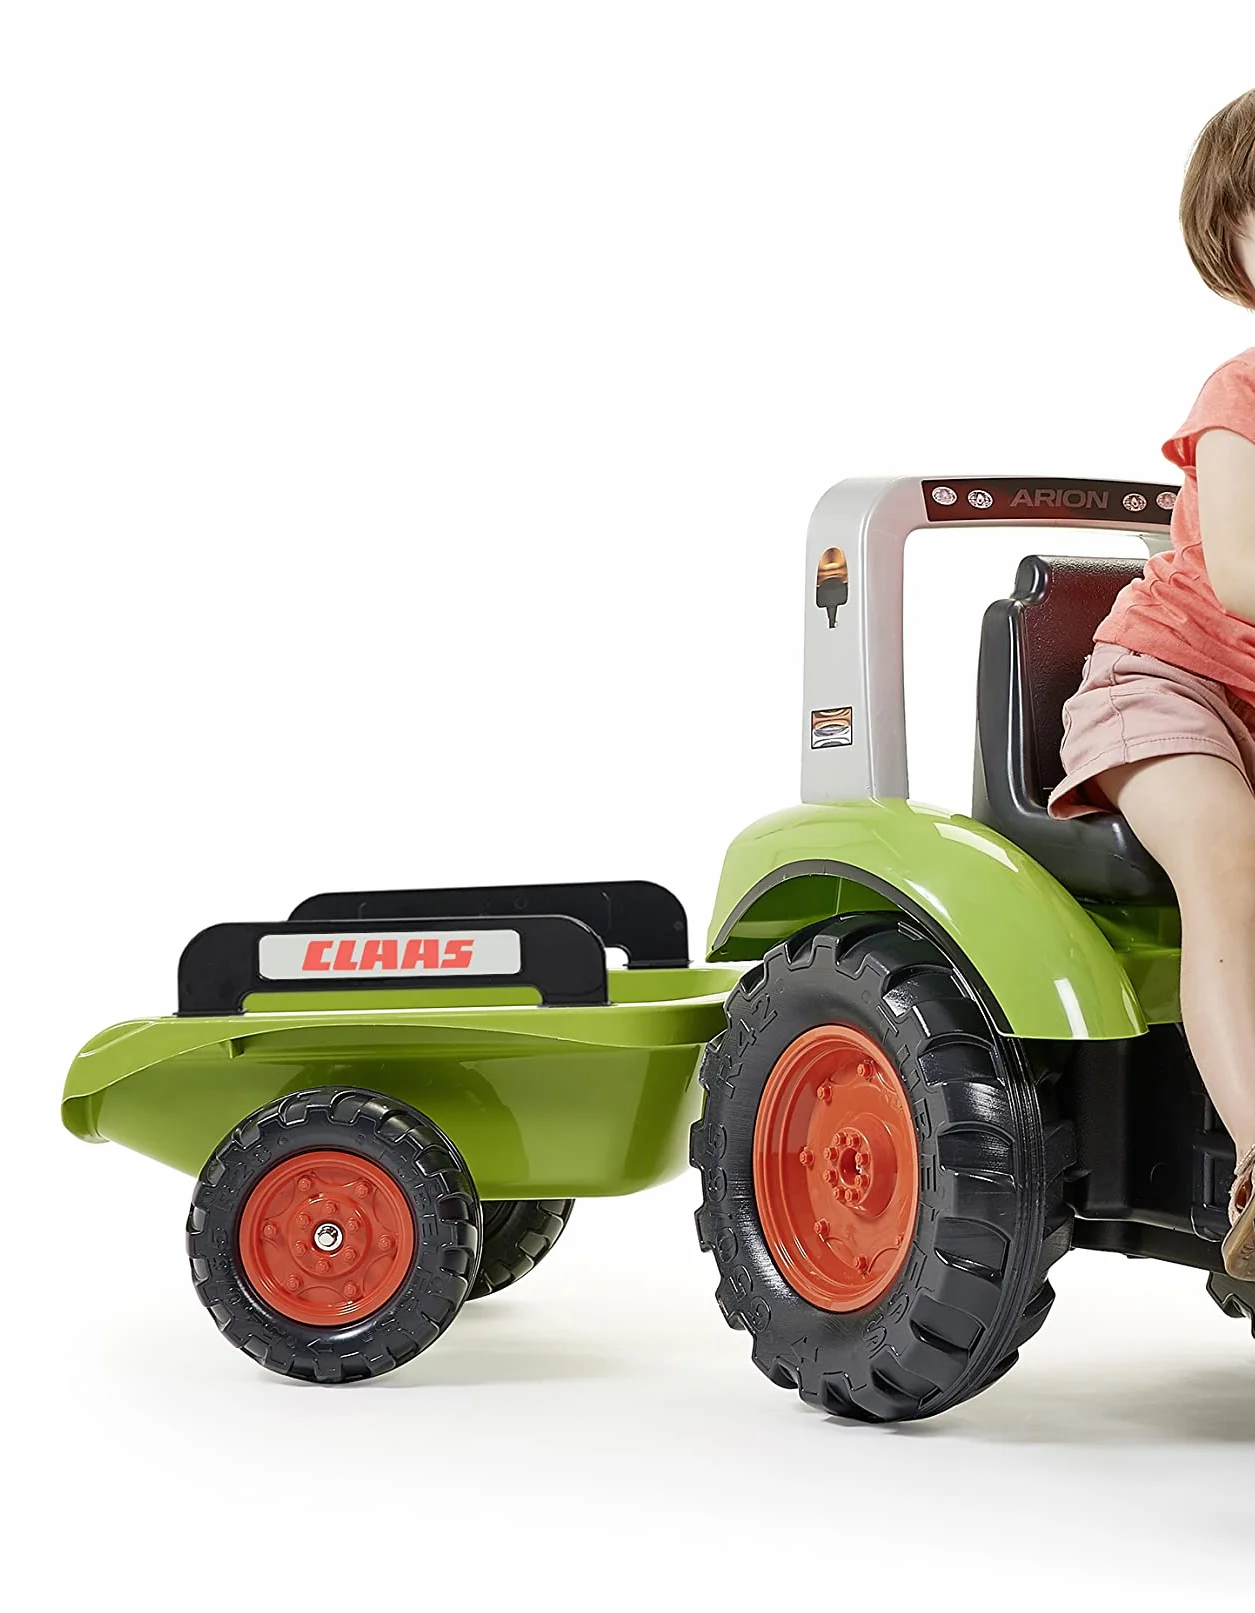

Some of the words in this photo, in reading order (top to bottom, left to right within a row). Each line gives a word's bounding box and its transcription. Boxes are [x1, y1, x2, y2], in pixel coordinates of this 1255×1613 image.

[1009, 488, 1109, 509] ARION
[302, 939, 474, 971] CLAAS
[716, 993, 779, 1099] R42
[863, 1005, 937, 1360] TUBELESS
